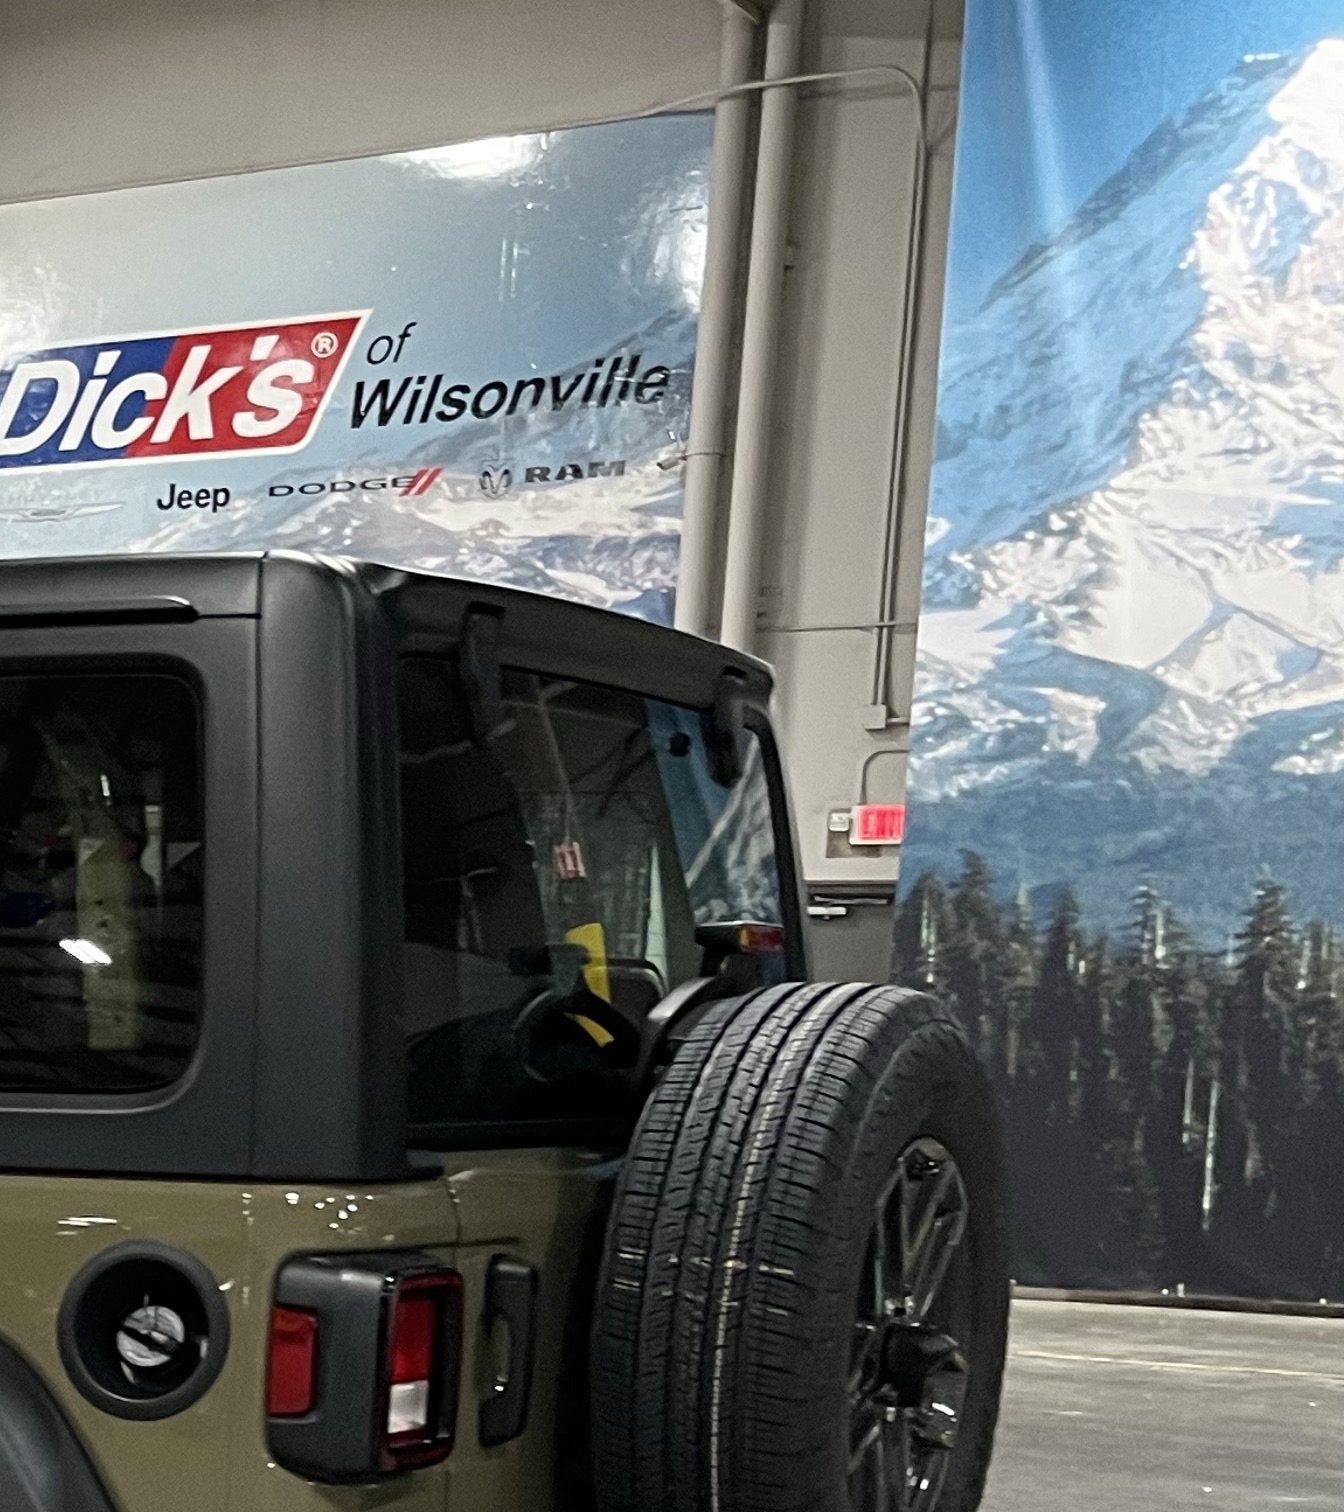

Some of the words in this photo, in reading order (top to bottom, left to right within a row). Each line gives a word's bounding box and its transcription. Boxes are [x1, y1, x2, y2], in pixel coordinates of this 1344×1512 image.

[366, 321, 417, 365] of
[350, 354, 671, 429] Wilsonville
[156, 483, 230, 512] Jeep
[268, 475, 418, 498] DODGE
[525, 460, 626, 484] RAM
